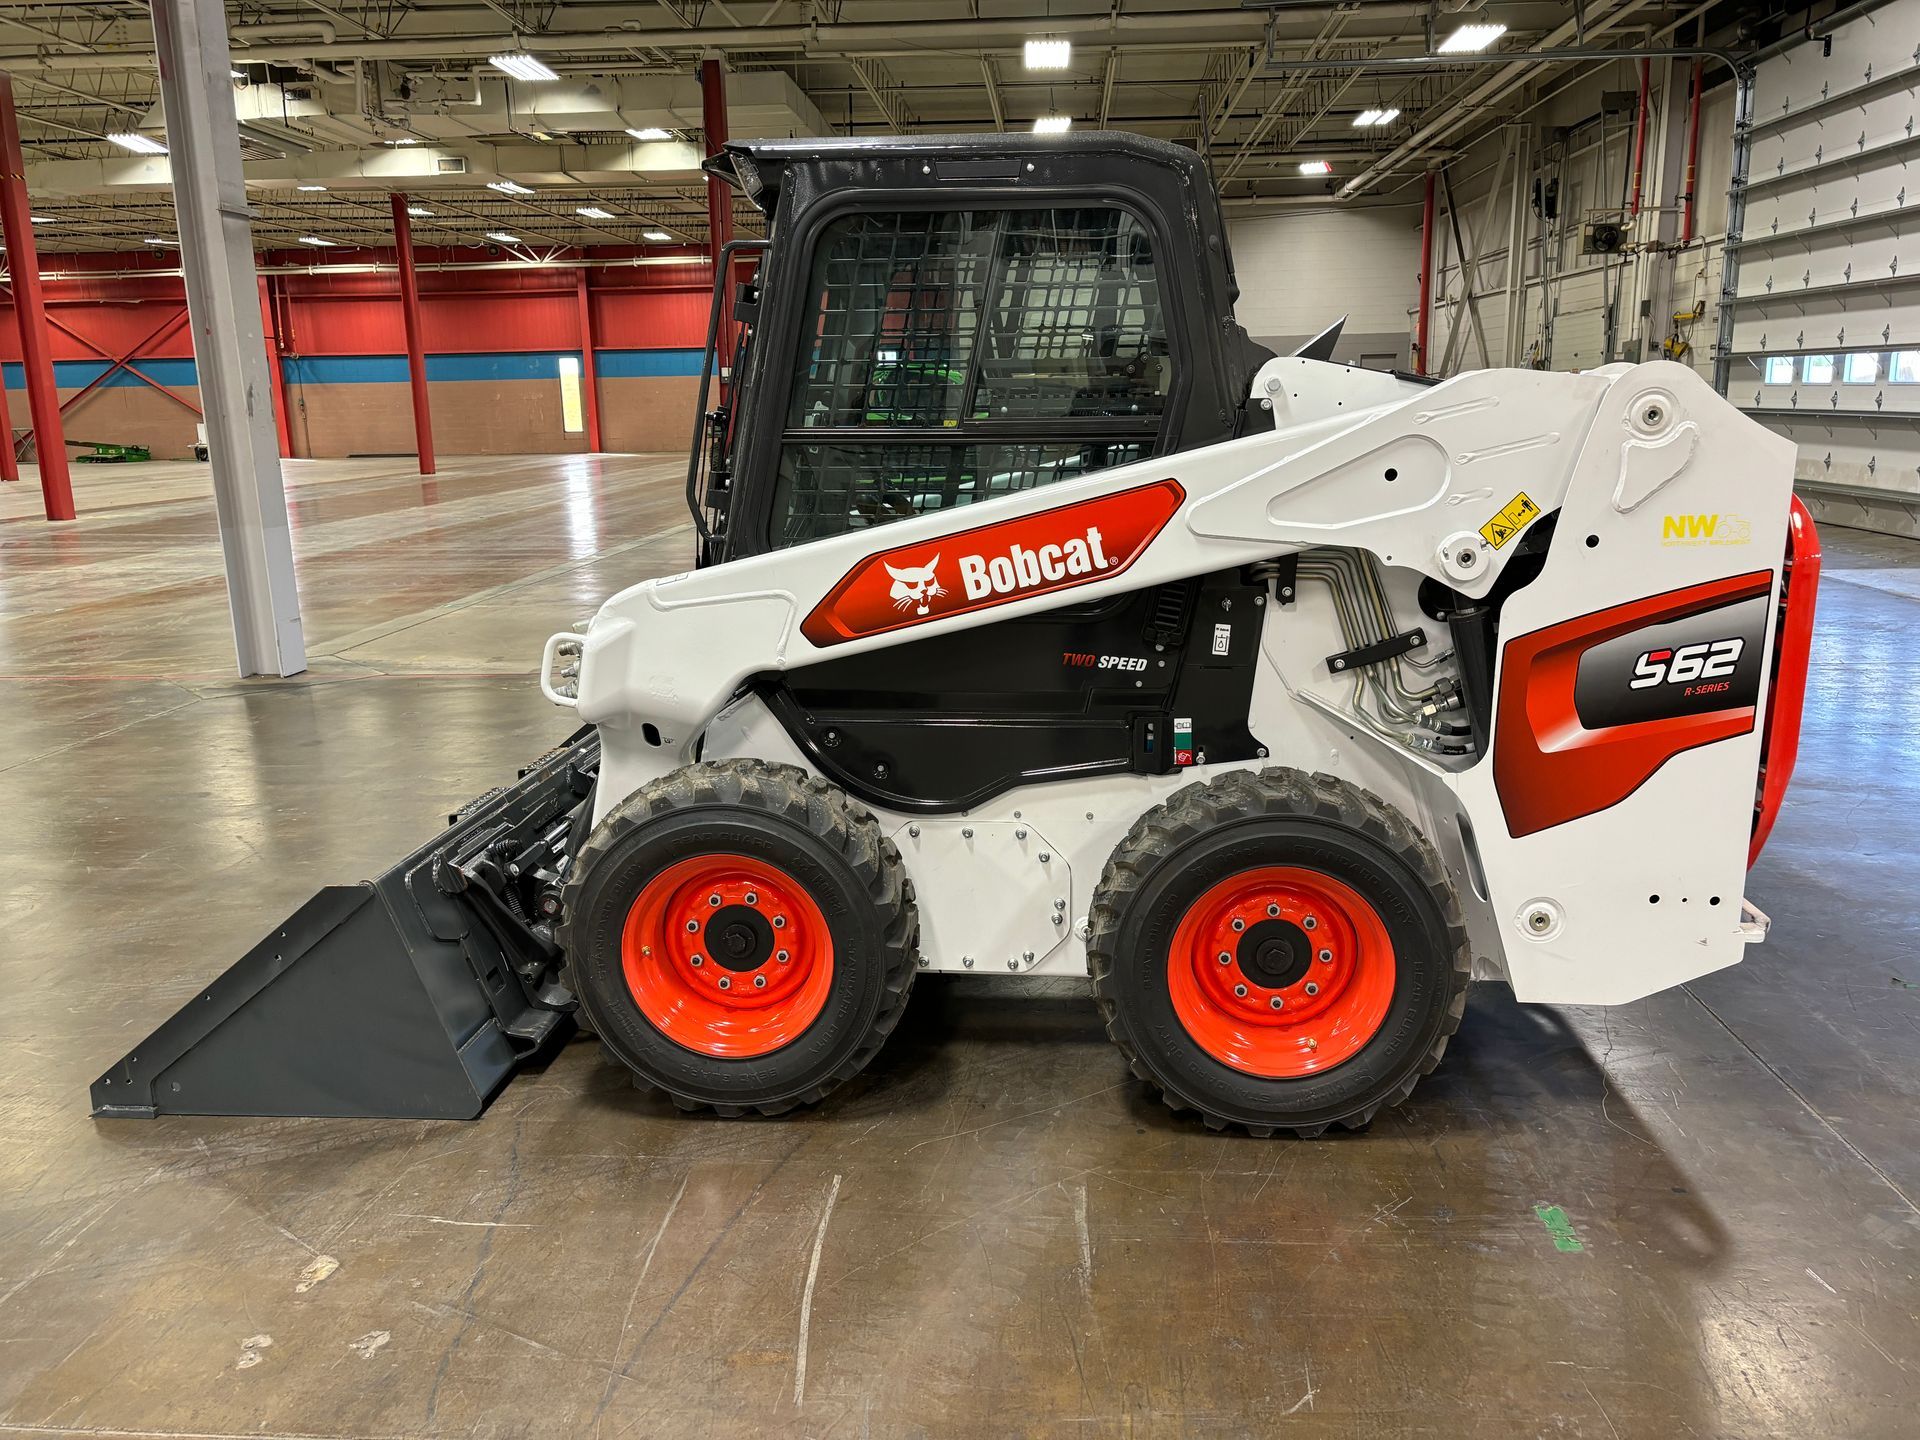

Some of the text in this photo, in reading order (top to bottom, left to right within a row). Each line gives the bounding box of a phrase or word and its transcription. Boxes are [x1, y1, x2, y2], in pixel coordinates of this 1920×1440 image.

[1663, 514, 1719, 539] NW
[959, 526, 1109, 601] Bobcat
[1062, 652, 1148, 672] TWO SPEED
[1629, 638, 1744, 690] S62
[1683, 681, 1731, 697] R-SERIES
